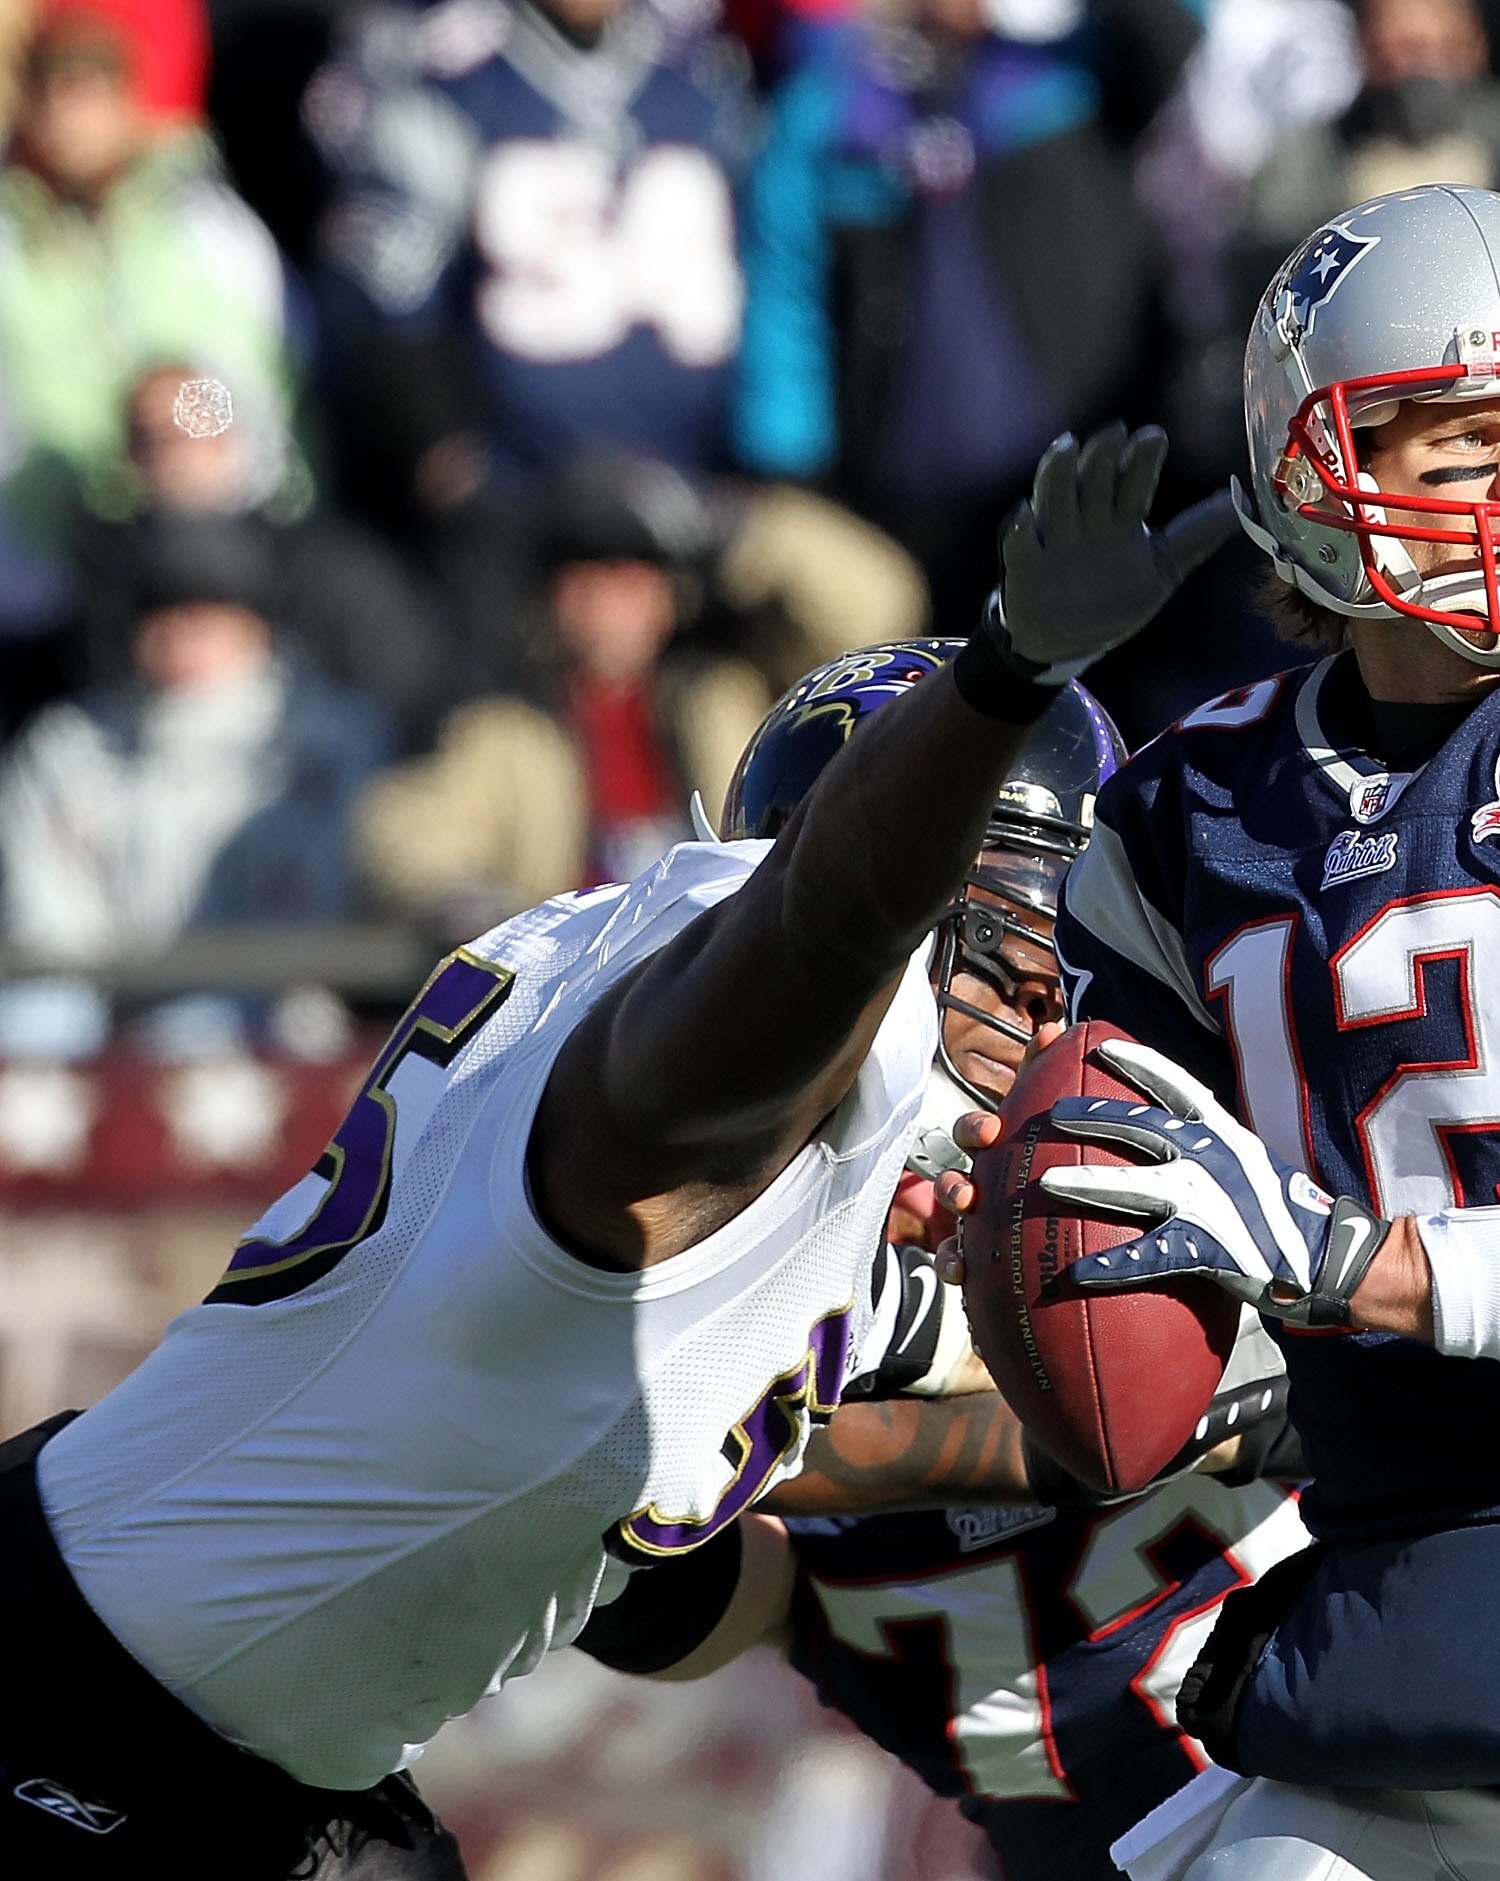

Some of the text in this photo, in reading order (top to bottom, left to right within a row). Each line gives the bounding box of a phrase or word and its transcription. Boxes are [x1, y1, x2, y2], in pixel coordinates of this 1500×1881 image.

[478, 138, 744, 368] 54
[998, 788, 1057, 810] RAVS
[1321, 832, 1398, 890] Patriots
[1011, 1121, 1051, 1390] NATIONAL FOOTBALL LEAGUE
[1037, 1216, 1060, 1298] Wilson
